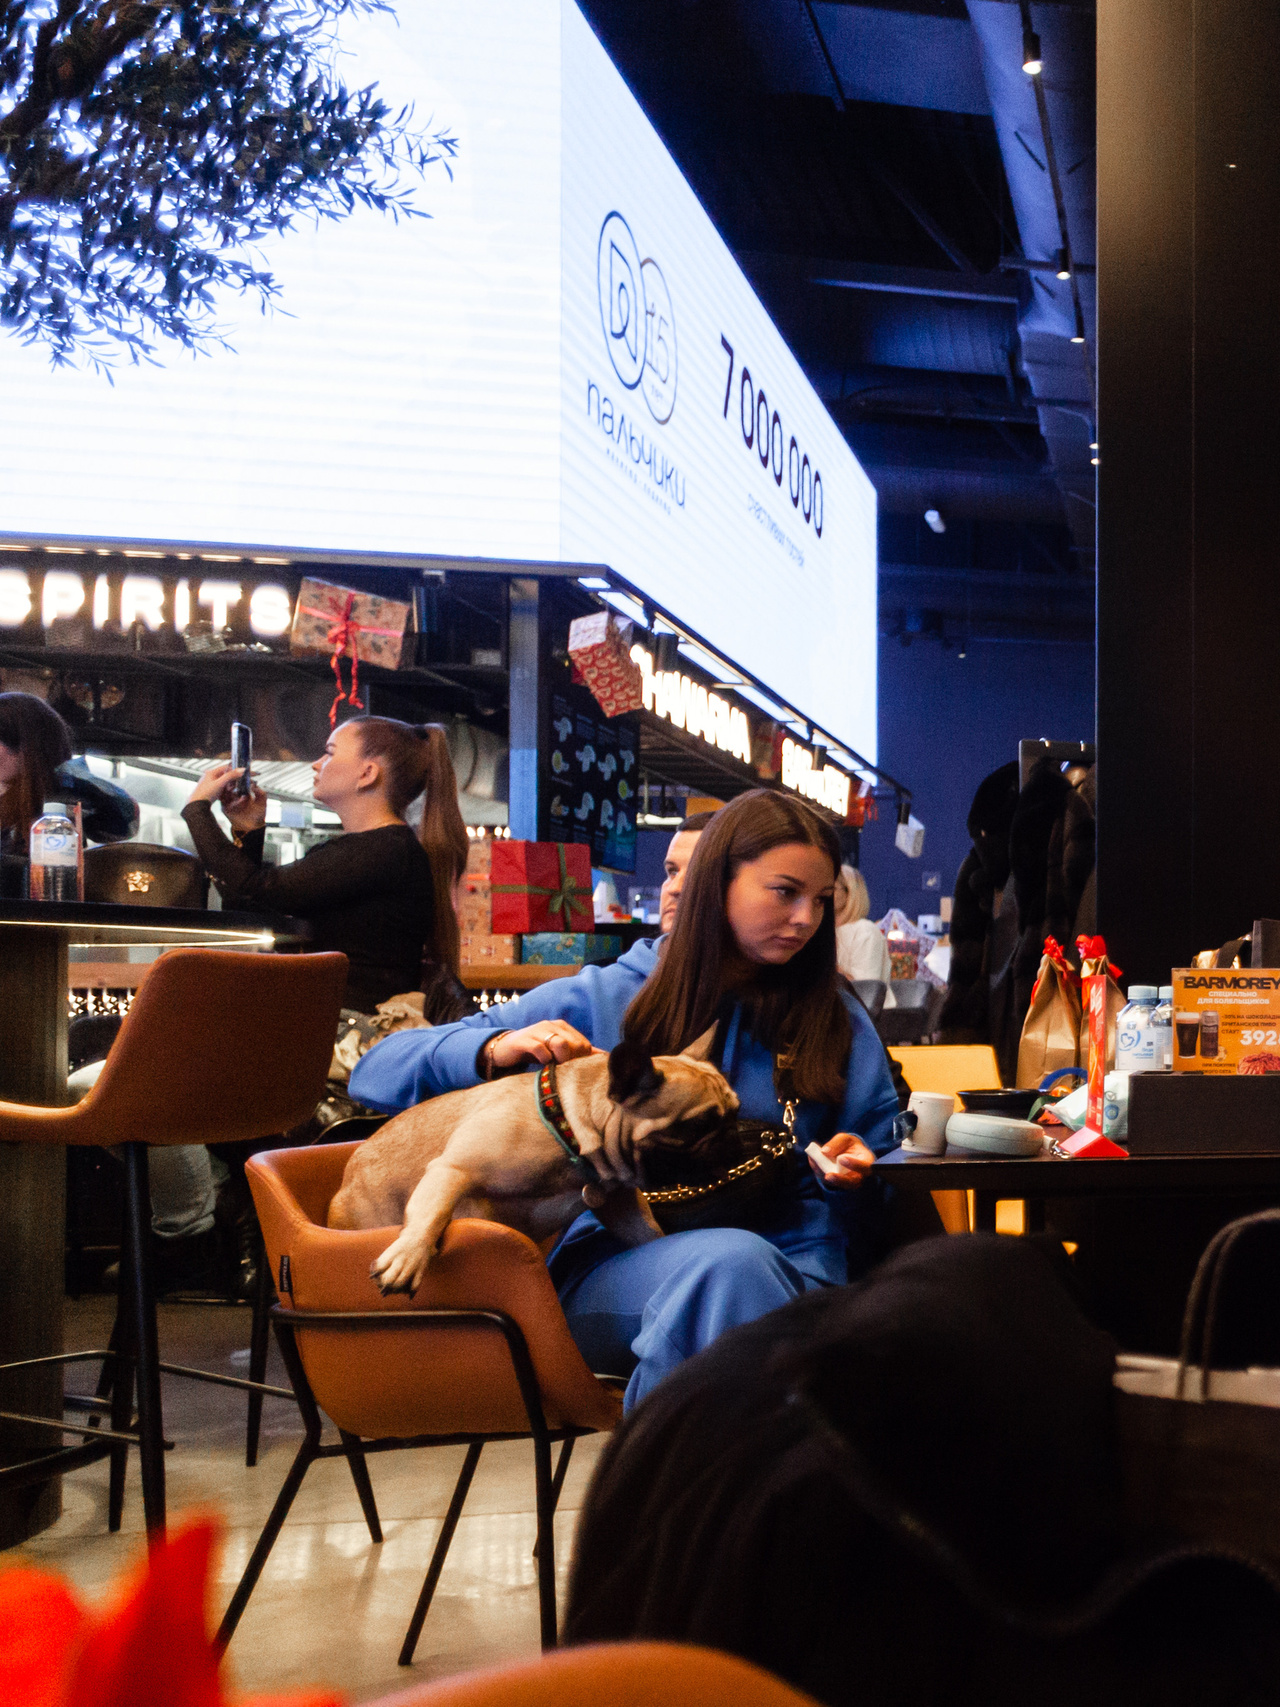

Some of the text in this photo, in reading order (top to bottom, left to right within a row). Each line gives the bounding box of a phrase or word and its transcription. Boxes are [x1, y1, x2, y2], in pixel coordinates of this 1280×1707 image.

[721, 332, 734, 419] 7
[741, 366, 783, 488] 000
[789, 435, 823, 539] 000
[0, 567, 292, 636] SPIRITS
[1208, 990, 1258, 998] СПЕЦИАЛЬНО
